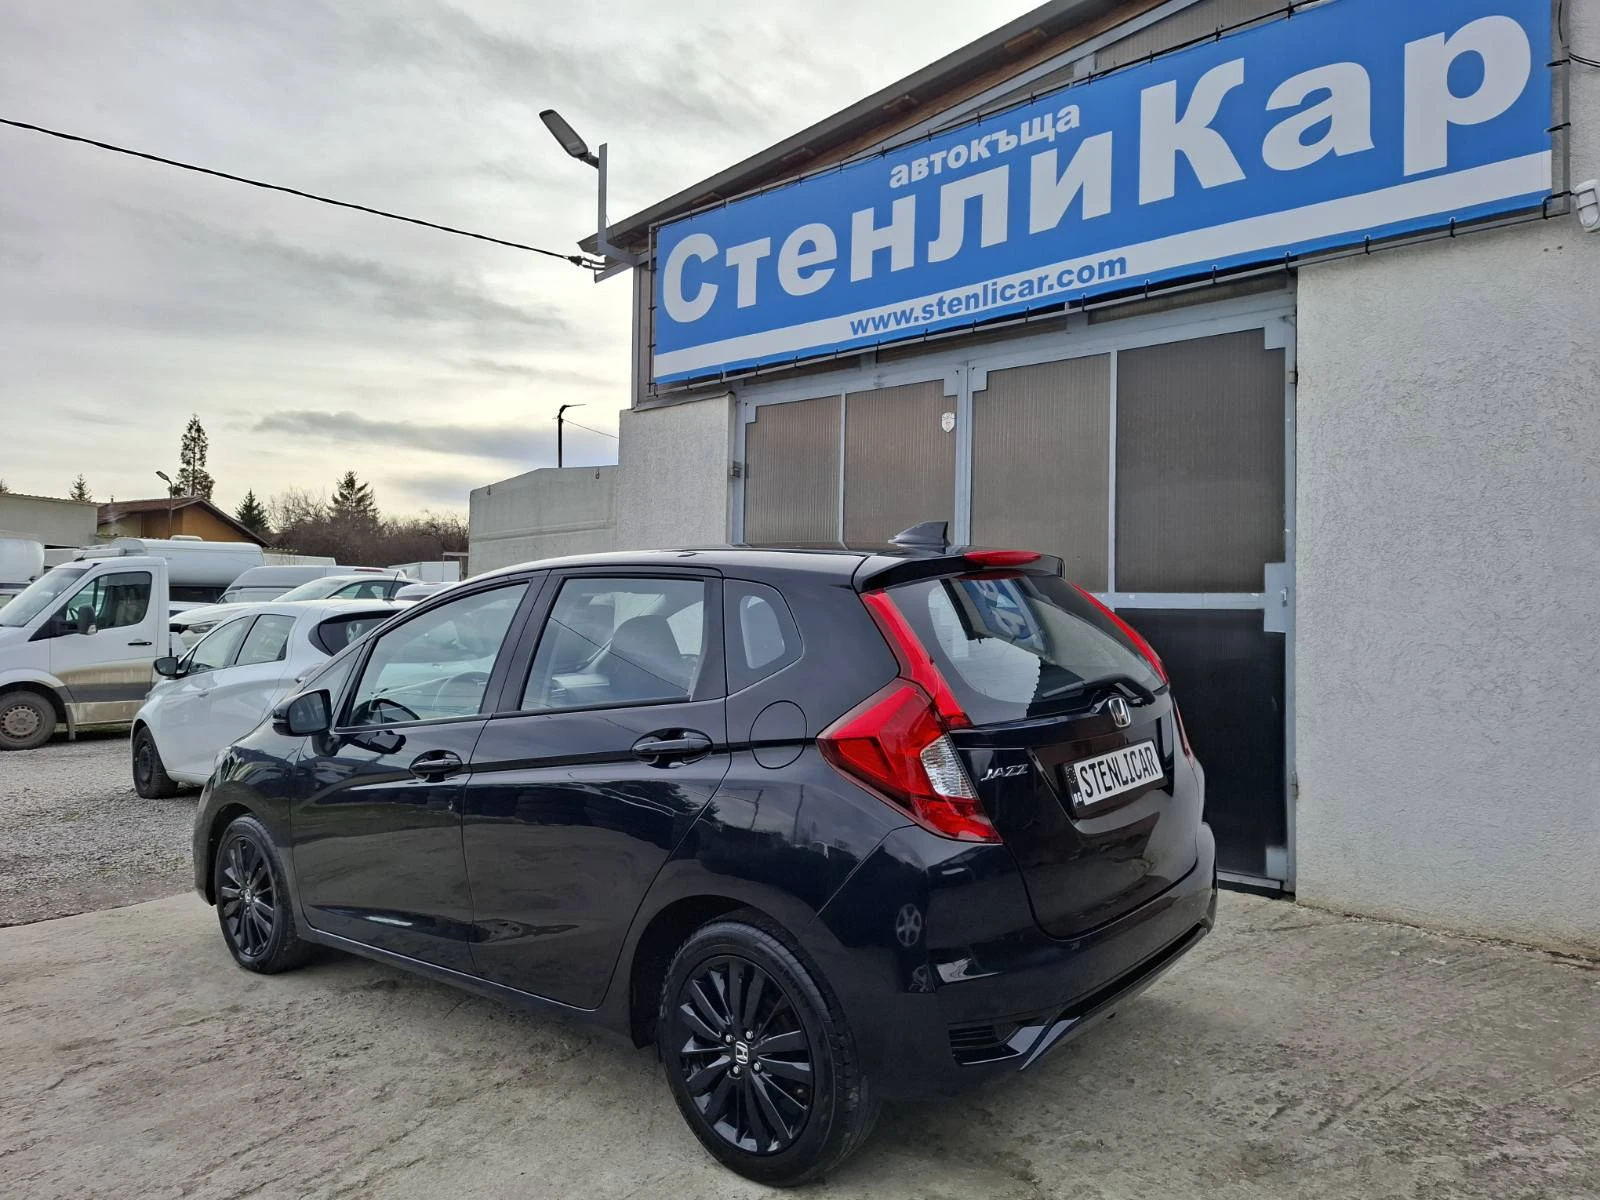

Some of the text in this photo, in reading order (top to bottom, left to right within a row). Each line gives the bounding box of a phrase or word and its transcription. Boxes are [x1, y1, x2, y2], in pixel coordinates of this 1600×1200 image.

[663, 15, 1531, 323] СтенлиКар
[889, 104, 1080, 188] автокъща
[850, 254, 1127, 337] www.stenlicar.com
[980, 763, 1029, 782] JAZZ
[1079, 745, 1158, 799] STENLICAR
